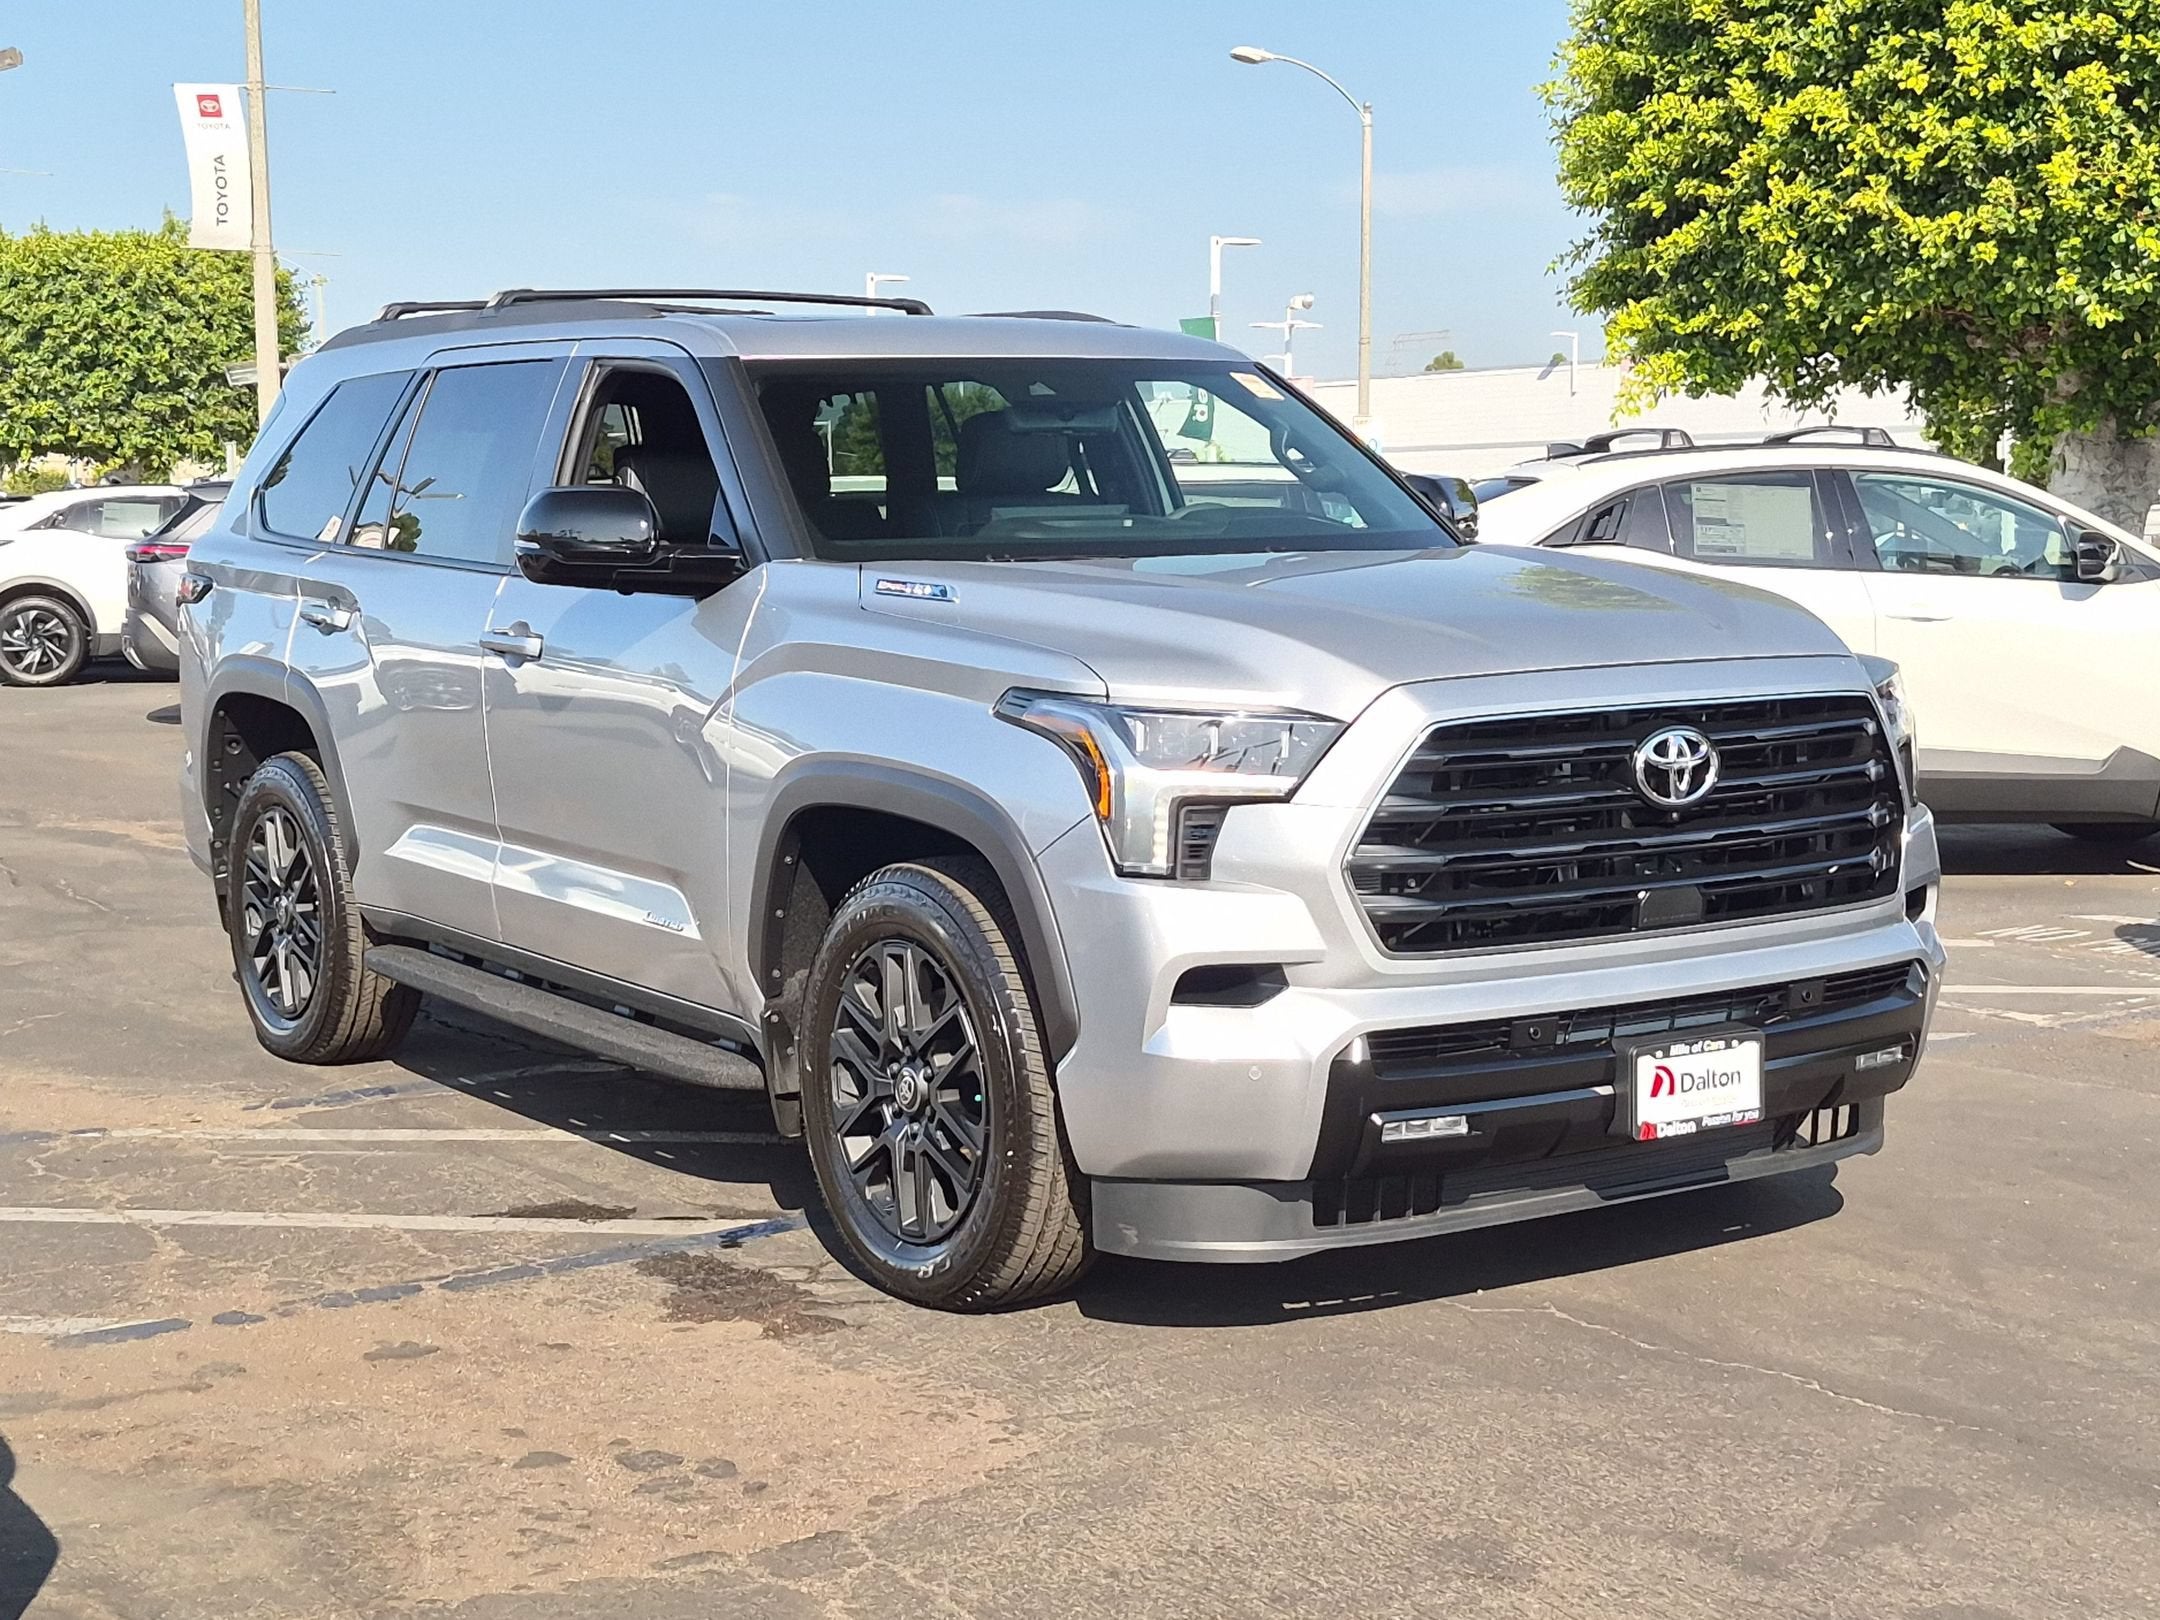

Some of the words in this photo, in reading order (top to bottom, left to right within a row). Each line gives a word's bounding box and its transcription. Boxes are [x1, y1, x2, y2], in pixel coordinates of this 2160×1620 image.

[213, 154, 229, 227] TOYOTA
[1691, 1040, 1703, 1053] of
[1680, 1069, 1741, 1093] Dalton
[1657, 1121, 1697, 1138] Dalton
